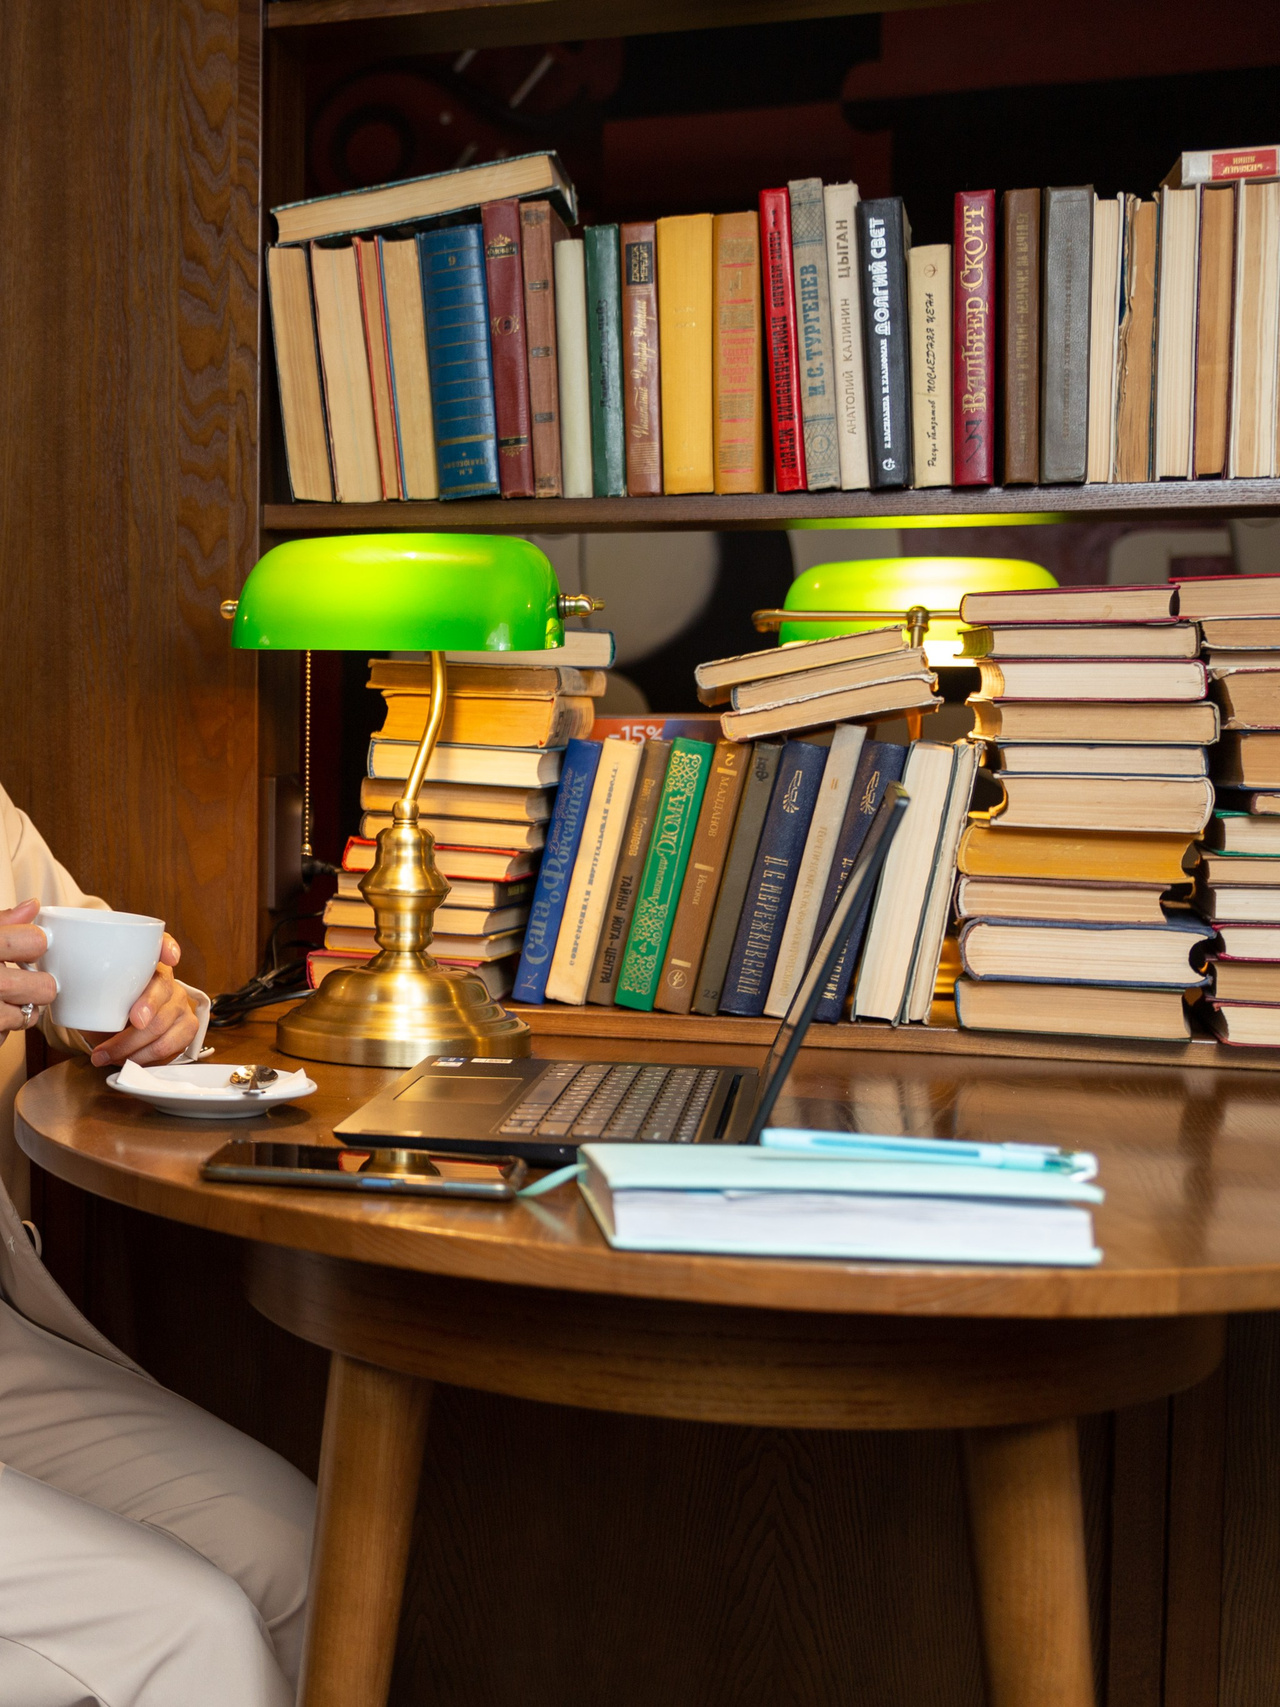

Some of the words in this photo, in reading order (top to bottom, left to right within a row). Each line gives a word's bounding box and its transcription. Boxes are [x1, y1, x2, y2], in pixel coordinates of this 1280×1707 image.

[836, 219, 852, 278] ЦЫГАН
[869, 217, 887, 259] СВЕТ
[960, 205, 987, 293] СКОТТ
[840, 298, 854, 362] КАЛИНИН
[869, 260, 892, 336] ДОЛГИЙ
[925, 292, 936, 324] ЦЕНА
[926, 326, 937, 394] ПОСЛЕДНЯЯ
[960, 296, 989, 413] ВАЛЬТЕР
[841, 370, 857, 435] АНАТОЛИЙ
[778, 428, 797, 469] МЕТЕОР
[927, 443, 939, 468] Расул
[542, 770, 588, 892] Форсайтах
[657, 793, 686, 859] ДЮМА
[549, 890, 561, 905] о
[617, 876, 633, 914] ТАЙНЫ
[692, 867, 707, 906] Истоки
[524, 898, 551, 966] Сага
[599, 916, 624, 985] ЙОГА-ЦЕНТРА
[736, 883, 783, 998] МЕРЕЖКОВСКИЙ
[703, 989, 718, 1000] 22
